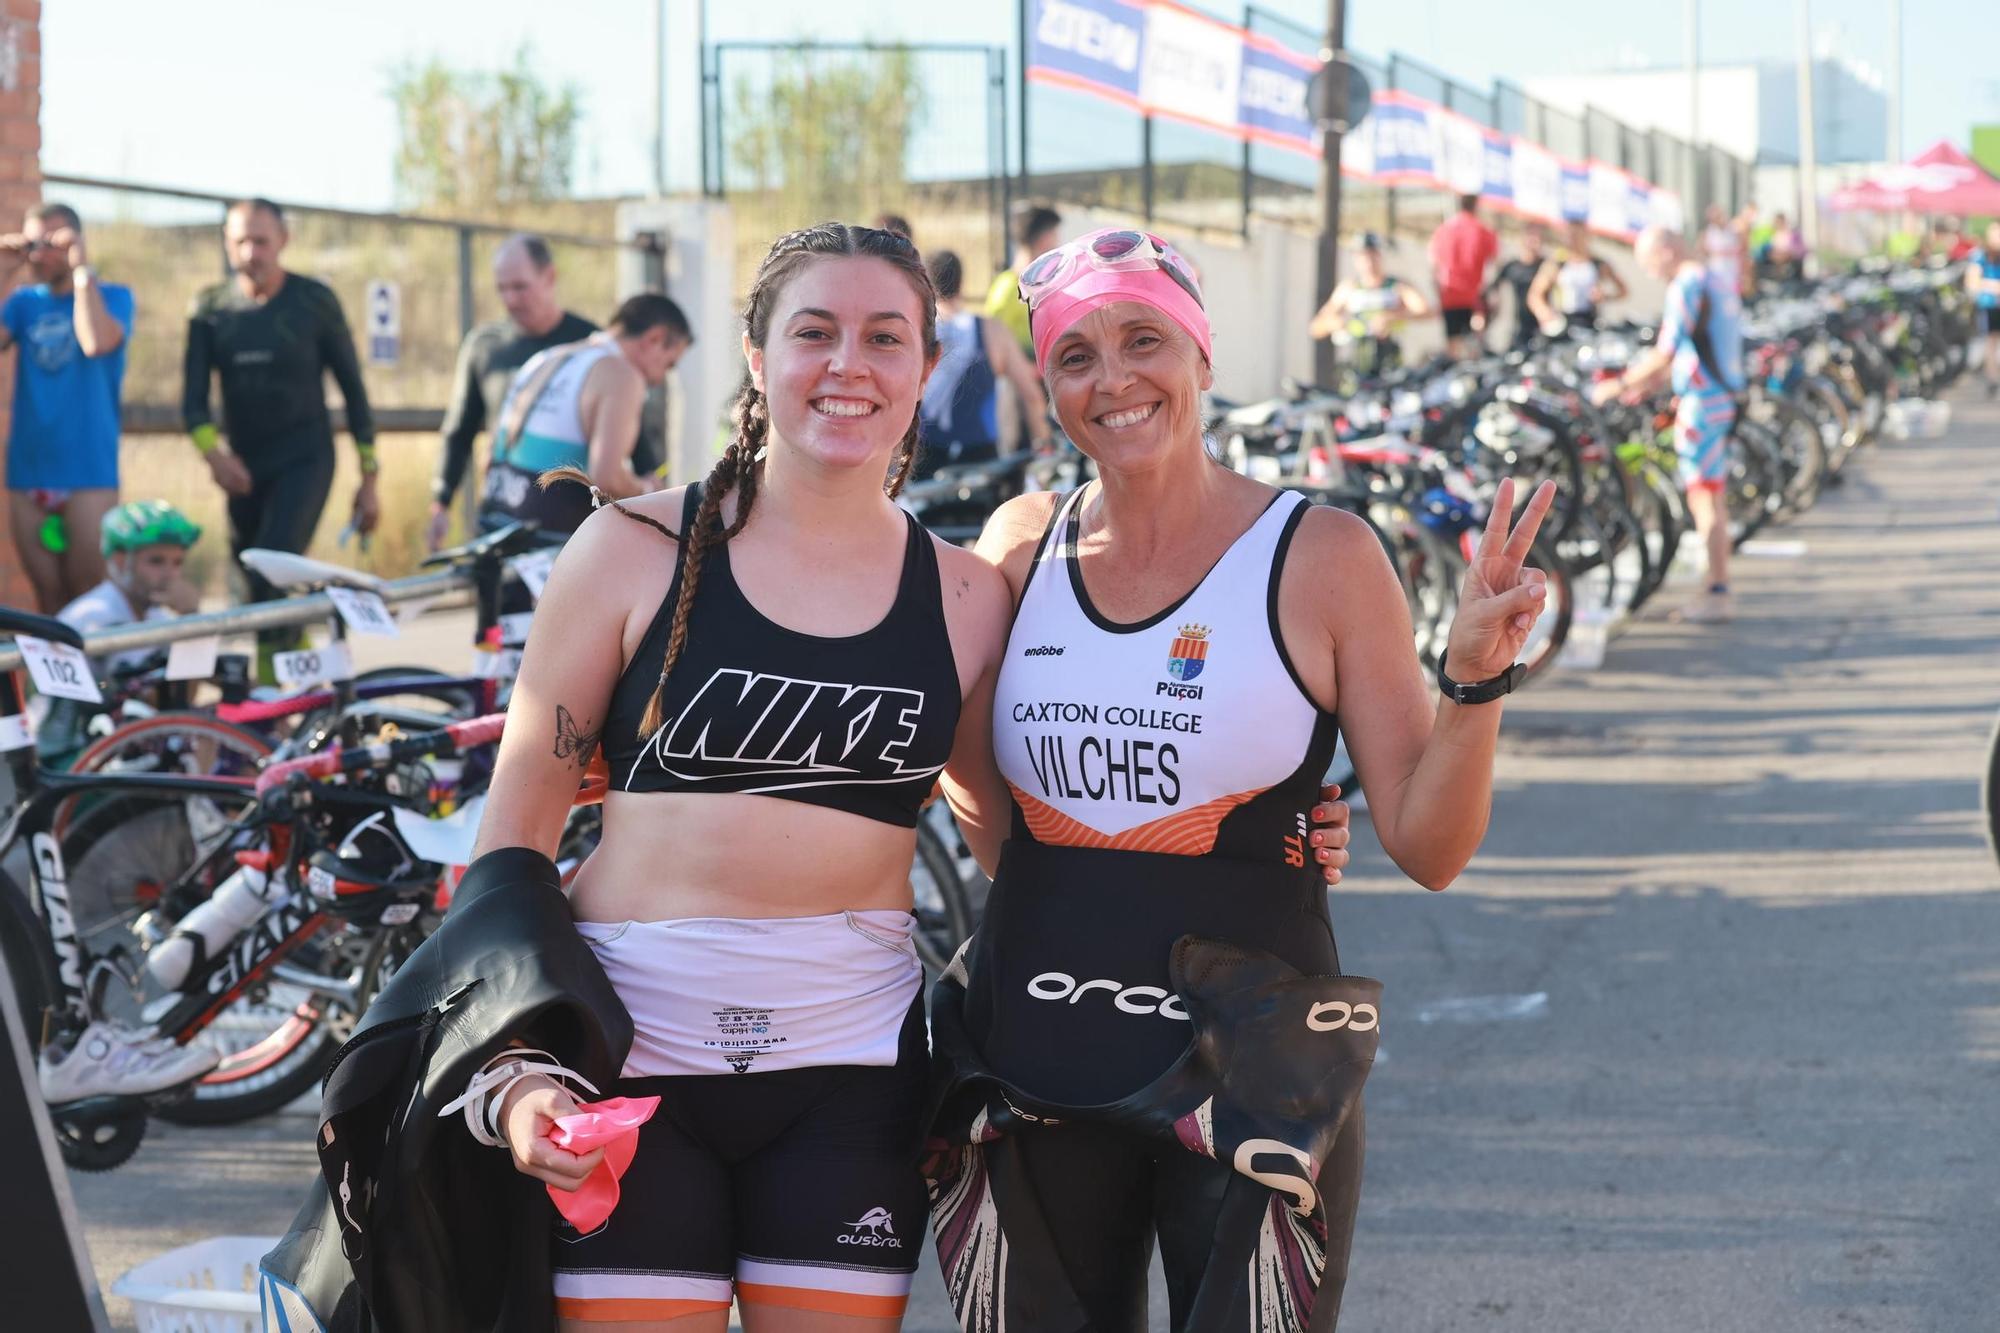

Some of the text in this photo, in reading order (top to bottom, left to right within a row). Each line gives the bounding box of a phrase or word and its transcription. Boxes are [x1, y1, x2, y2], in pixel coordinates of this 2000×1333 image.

[42, 656, 82, 686] 102
[284, 653, 321, 676] 100
[1156, 682, 1204, 701] Puçol
[664, 668, 926, 774] NIKE
[1013, 702, 1202, 734] CAXTON COLLEGE
[1025, 735, 1181, 806] VILCHES
[704, 1036, 787, 1047] www.austral.es
[836, 1234, 903, 1248] austral
